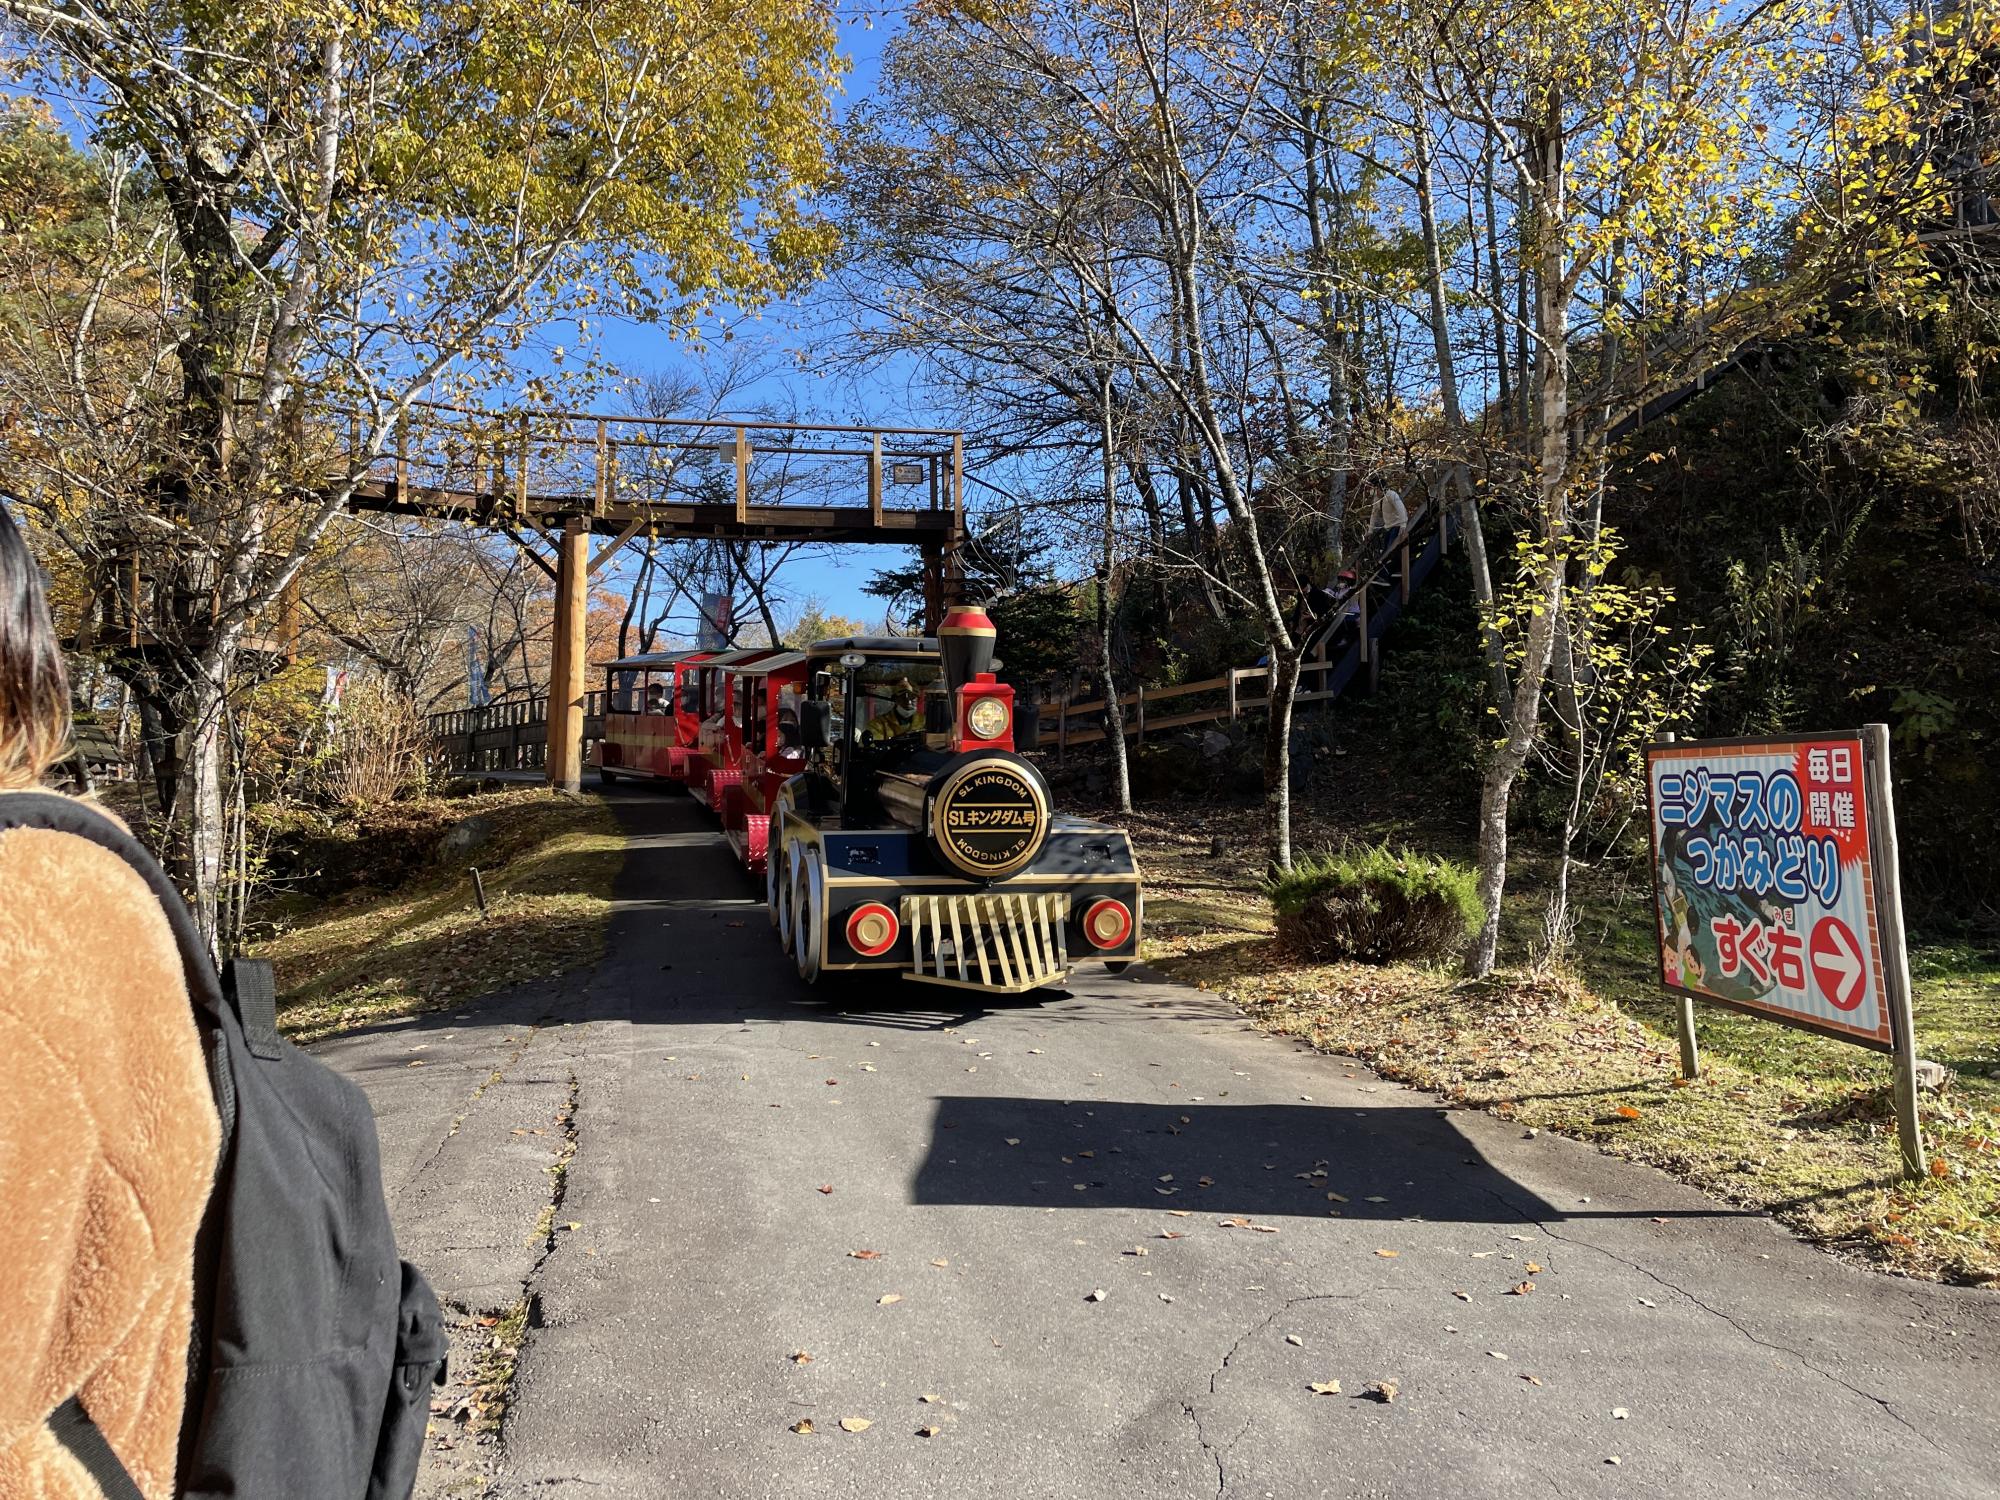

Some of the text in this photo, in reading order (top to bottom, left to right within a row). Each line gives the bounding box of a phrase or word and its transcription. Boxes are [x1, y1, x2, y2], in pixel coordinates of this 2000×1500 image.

[1807, 748, 1852, 785] 毎日
[958, 775, 1028, 798] SL KINGDOM
[1659, 770, 1801, 832] ニジマスの
[948, 810, 1036, 827] SLキングダム号
[1809, 791, 1855, 829] 開催
[957, 838, 1026, 861] SL KINGDOM
[1687, 835, 1839, 904] つかみどり
[1712, 913, 1808, 995] すぐ右
